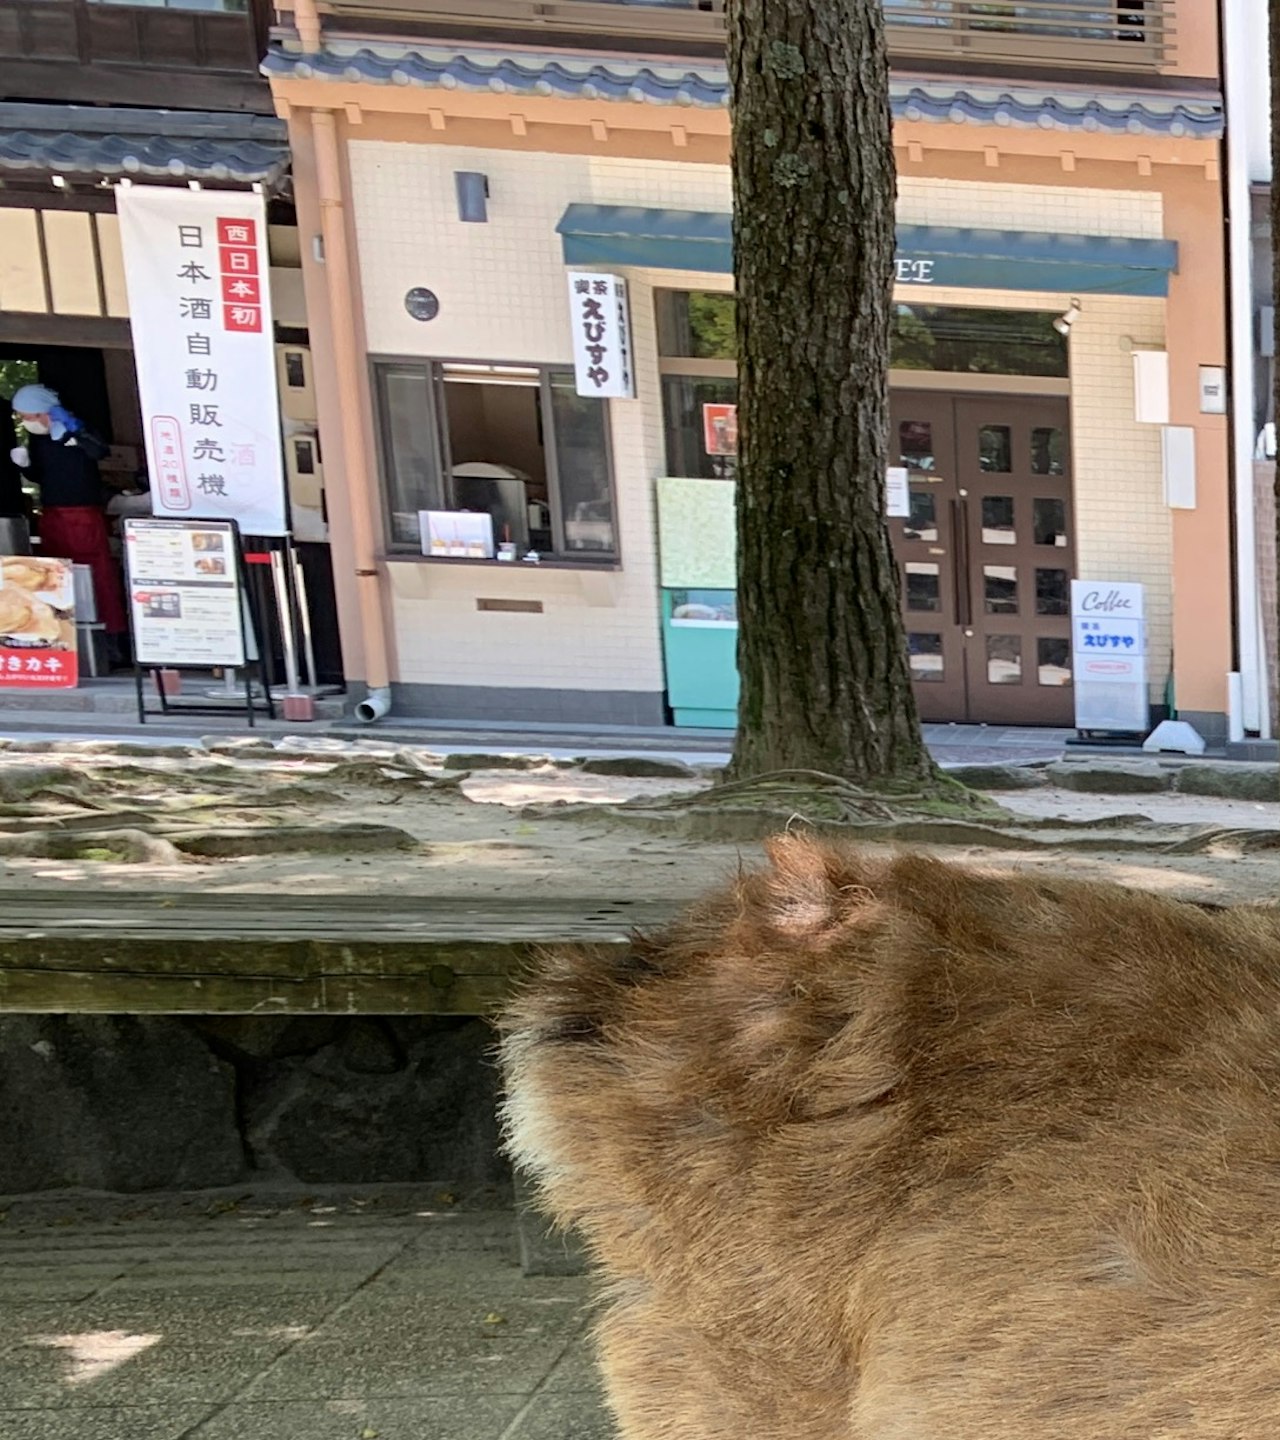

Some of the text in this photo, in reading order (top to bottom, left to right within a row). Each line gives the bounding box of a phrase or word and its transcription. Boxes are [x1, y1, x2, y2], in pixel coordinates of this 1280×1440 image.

[225, 225, 256, 326] 西日本初
[894, 259, 934, 282] EE
[574, 279, 608, 295] 喫茶
[582, 297, 609, 388] えびすや
[177, 224, 228, 497] 日本酒自動販売機
[1082, 590, 1133, 612] Coffee
[1084, 633, 1135, 648] えびすや
[0, 655, 62, 673] きカキ
